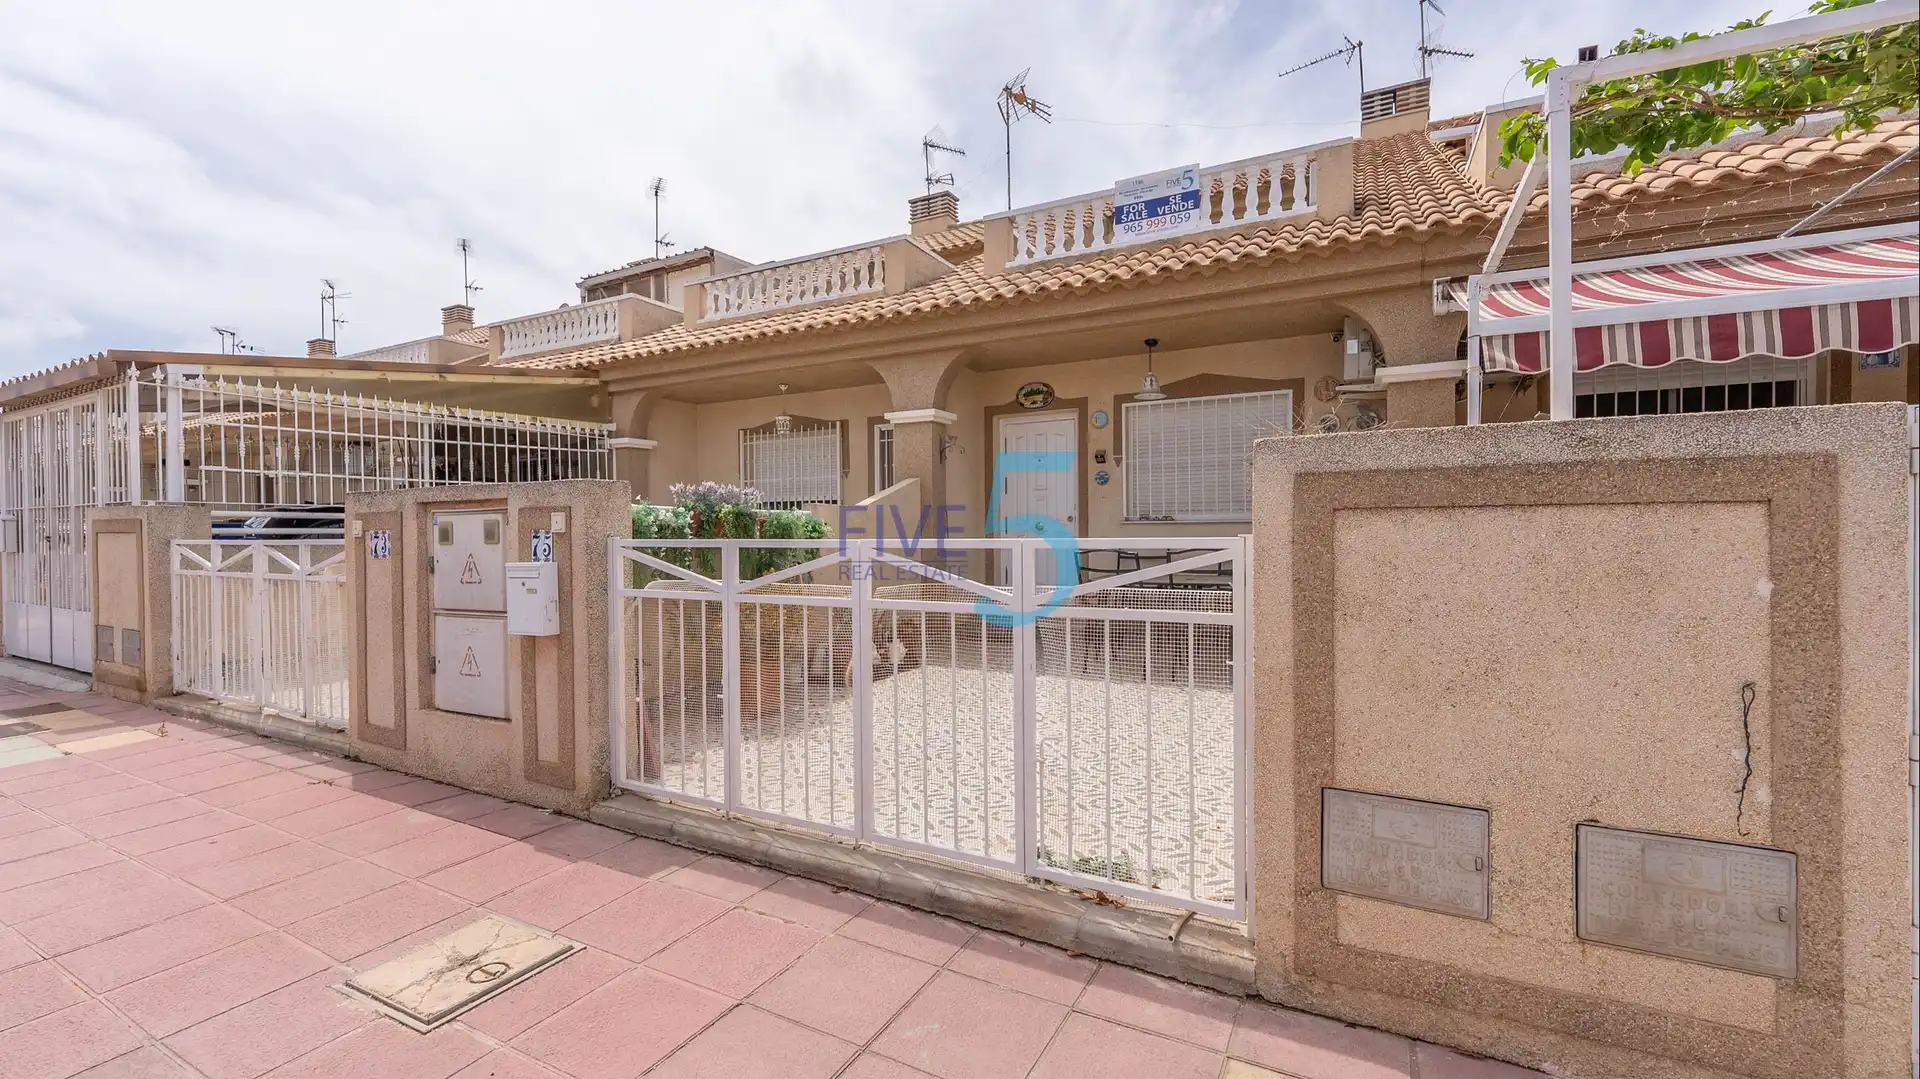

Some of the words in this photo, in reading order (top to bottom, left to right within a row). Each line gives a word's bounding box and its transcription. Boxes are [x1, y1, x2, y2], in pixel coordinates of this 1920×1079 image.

[1166, 177, 1181, 187] FIVE
[1181, 169, 1194, 190] 5
[1123, 202, 1145, 214] FOR
[1157, 200, 1195, 215] VENDE
[1169, 194, 1182, 205] SE
[1120, 210, 1148, 223] SALE
[1123, 221, 1143, 234] 965
[1146, 216, 1167, 229] 999
[1169, 212, 1191, 225] 059
[373, 535, 387, 555] 73
[532, 535, 552, 557] 75
